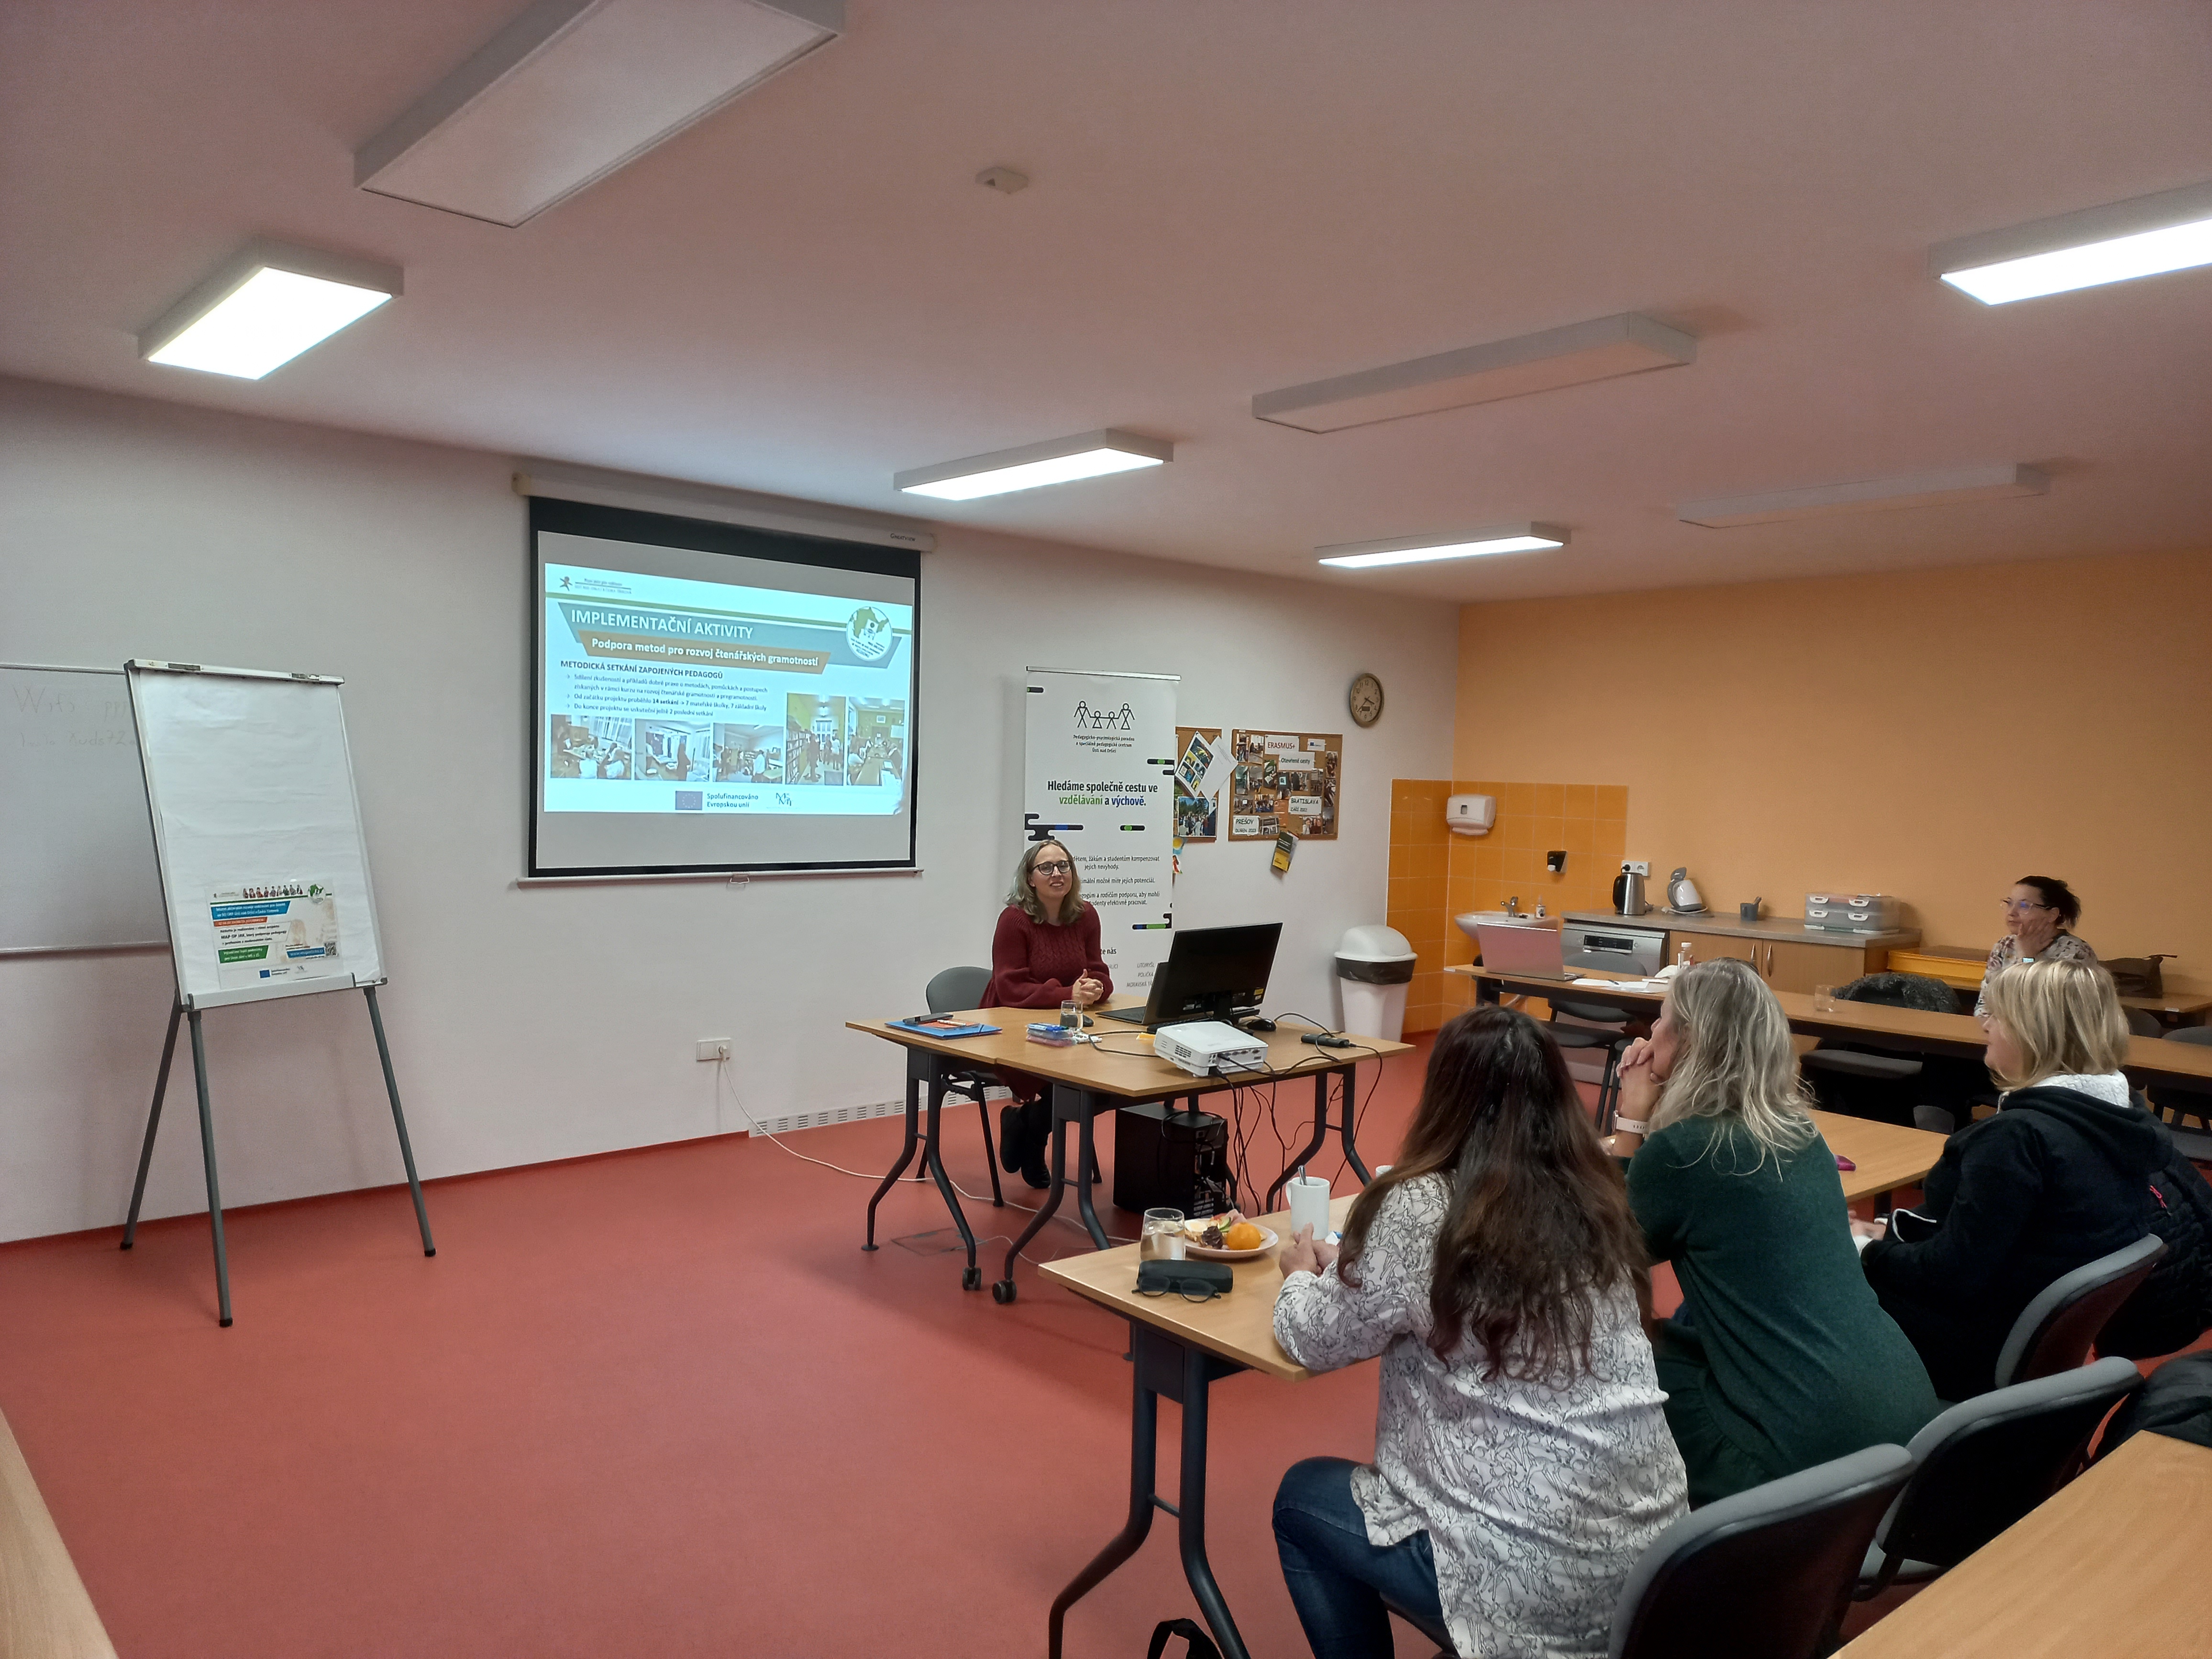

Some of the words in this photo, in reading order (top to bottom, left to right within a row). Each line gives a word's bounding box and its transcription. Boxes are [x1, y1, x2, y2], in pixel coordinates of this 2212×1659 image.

[571, 609, 692, 634] IMPLEMENTAČNÍ
[694, 622, 753, 639] AKTIVITY
[592, 638, 632, 651] Podpora
[635, 643, 666, 653] metod
[668, 647, 684, 656] pro
[686, 648, 713, 660] rozvoj
[715, 648, 766, 663] čtenářských
[561, 661, 606, 670] METODICKÁ
[607, 664, 637, 673] SETKÁNÍ
[639, 666, 683, 676] ZAPOJENÝCH
[685, 670, 723, 679] PEDAGOGŮ
[1048, 780, 1084, 791] Hledáme
[1086, 781, 1123, 794] společně
[1125, 783, 1147, 793] cestu
[1148, 785, 1158, 793] ve
[1059, 794, 1103, 805] vzdělávání
[1105, 797, 1110, 806] a
[1111, 795, 1147, 808] výchově.
